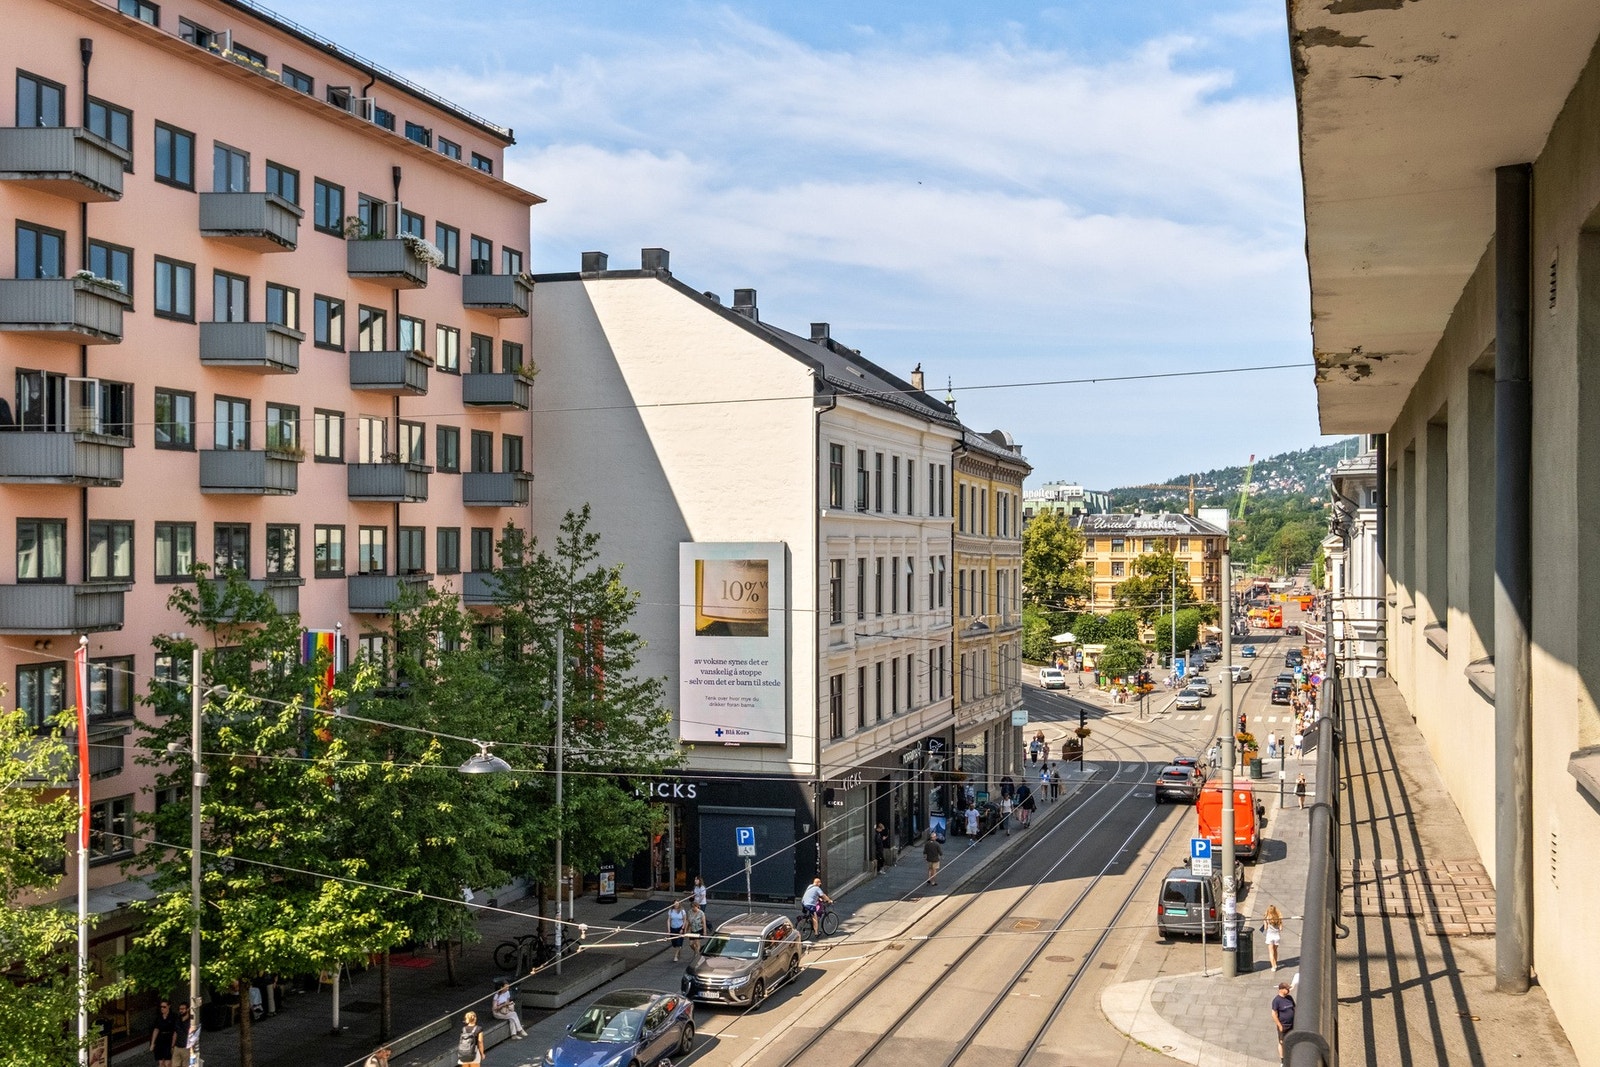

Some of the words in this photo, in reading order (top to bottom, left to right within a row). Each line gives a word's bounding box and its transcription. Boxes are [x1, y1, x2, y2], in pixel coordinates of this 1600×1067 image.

[1093, 517, 1132, 530] United
[1135, 521, 1177, 529] BAKERIES
[721, 579, 759, 602] 10%
[748, 658, 759, 666] det
[700, 668, 733, 676] vanskelig
[738, 669, 762, 677] stoppe
[715, 678, 727, 686] det
[842, 771, 862, 791] KICKS
[740, 830, 750, 843] P
[1195, 841, 1206, 856] P
